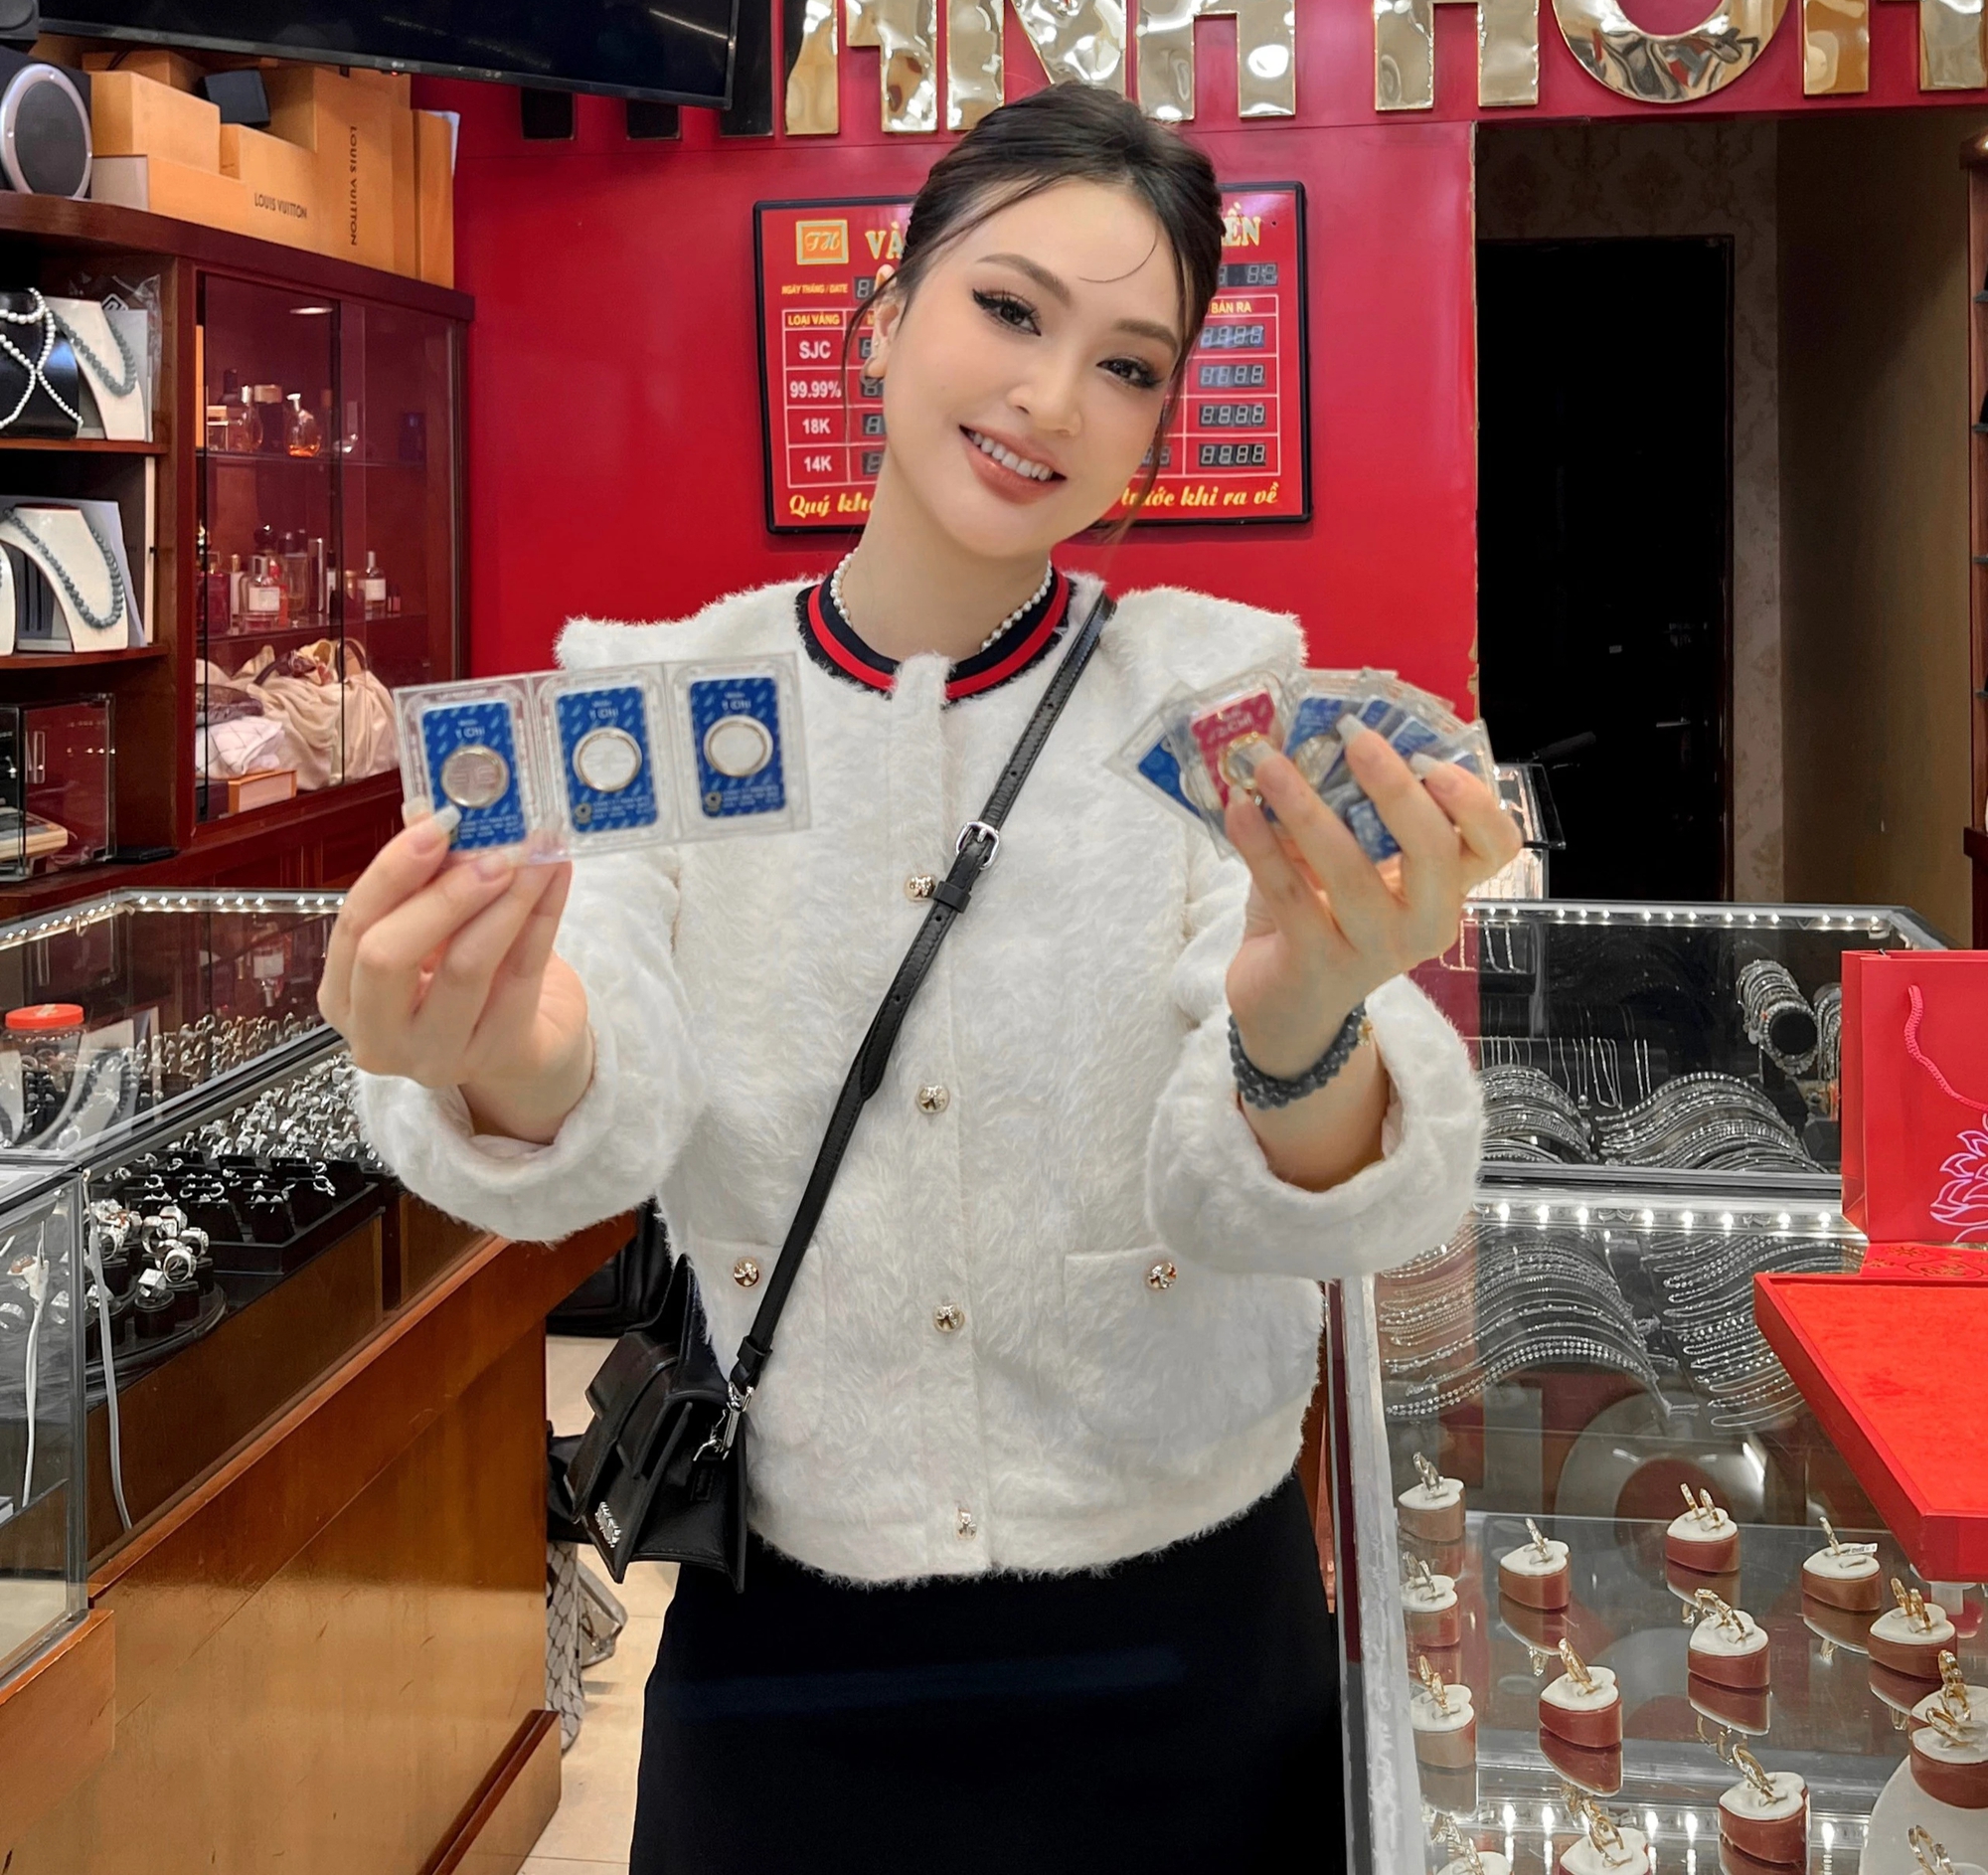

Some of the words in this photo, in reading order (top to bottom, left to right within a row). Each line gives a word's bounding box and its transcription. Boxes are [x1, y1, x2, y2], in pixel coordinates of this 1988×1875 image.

[253, 192, 276, 211] LOUIS
[277, 199, 307, 219] VUITTON
[865, 221, 904, 259] VÀ
[1222, 202, 1261, 247] ỀN
[1236, 300, 1252, 313] RA
[812, 311, 840, 326] VÀNG
[798, 340, 831, 359] SJC
[789, 380, 842, 398] 99.99%
[802, 418, 831, 434] 18K
[804, 455, 832, 472] 14K
[789, 494, 831, 518] Quý
[837, 492, 873, 513] kh
[1180, 484, 1220, 507] khi
[1223, 491, 1248, 507] ra
[1253, 481, 1280, 505] về
